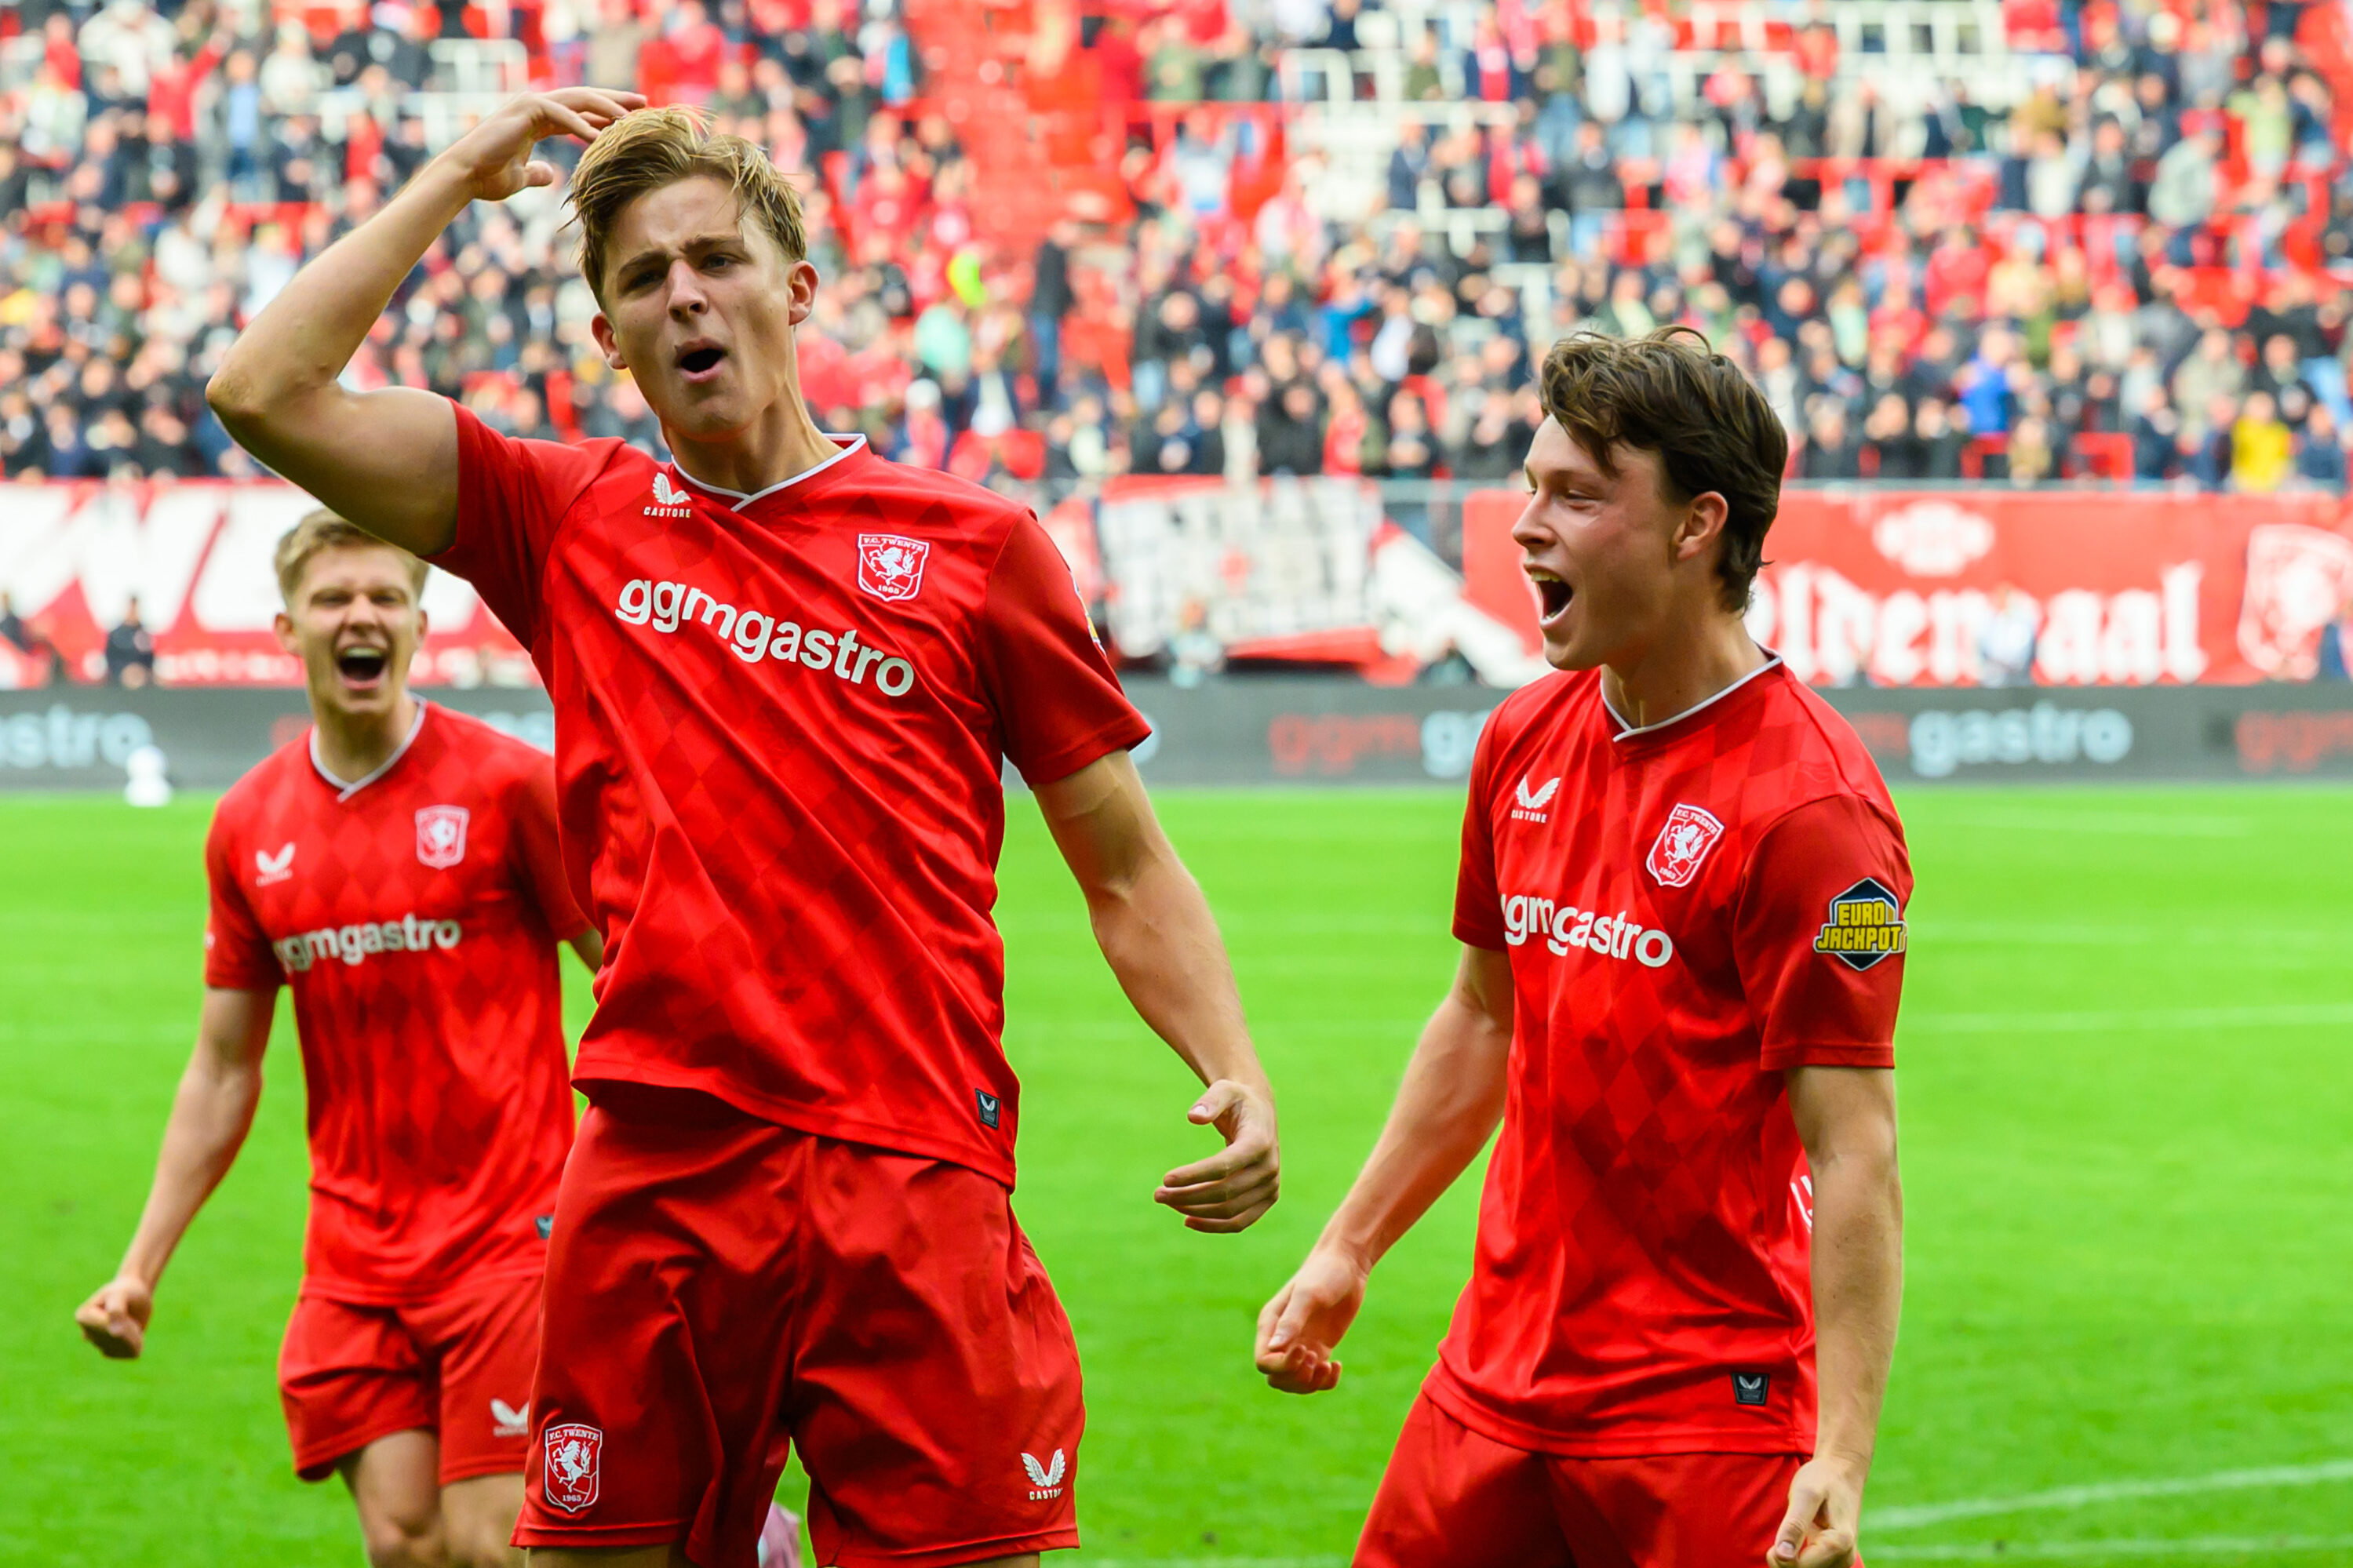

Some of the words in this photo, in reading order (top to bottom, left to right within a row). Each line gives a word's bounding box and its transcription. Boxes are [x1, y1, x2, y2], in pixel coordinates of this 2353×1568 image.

[643, 506, 691, 518] CASTORE
[881, 538, 924, 551] TWENTE
[878, 584, 900, 595] 1965
[615, 579, 915, 697] ggmgastro
[1838, 902, 1885, 926] EURO
[1817, 926, 1902, 951] JACKPOT
[563, 1429, 599, 1441] TWENTE
